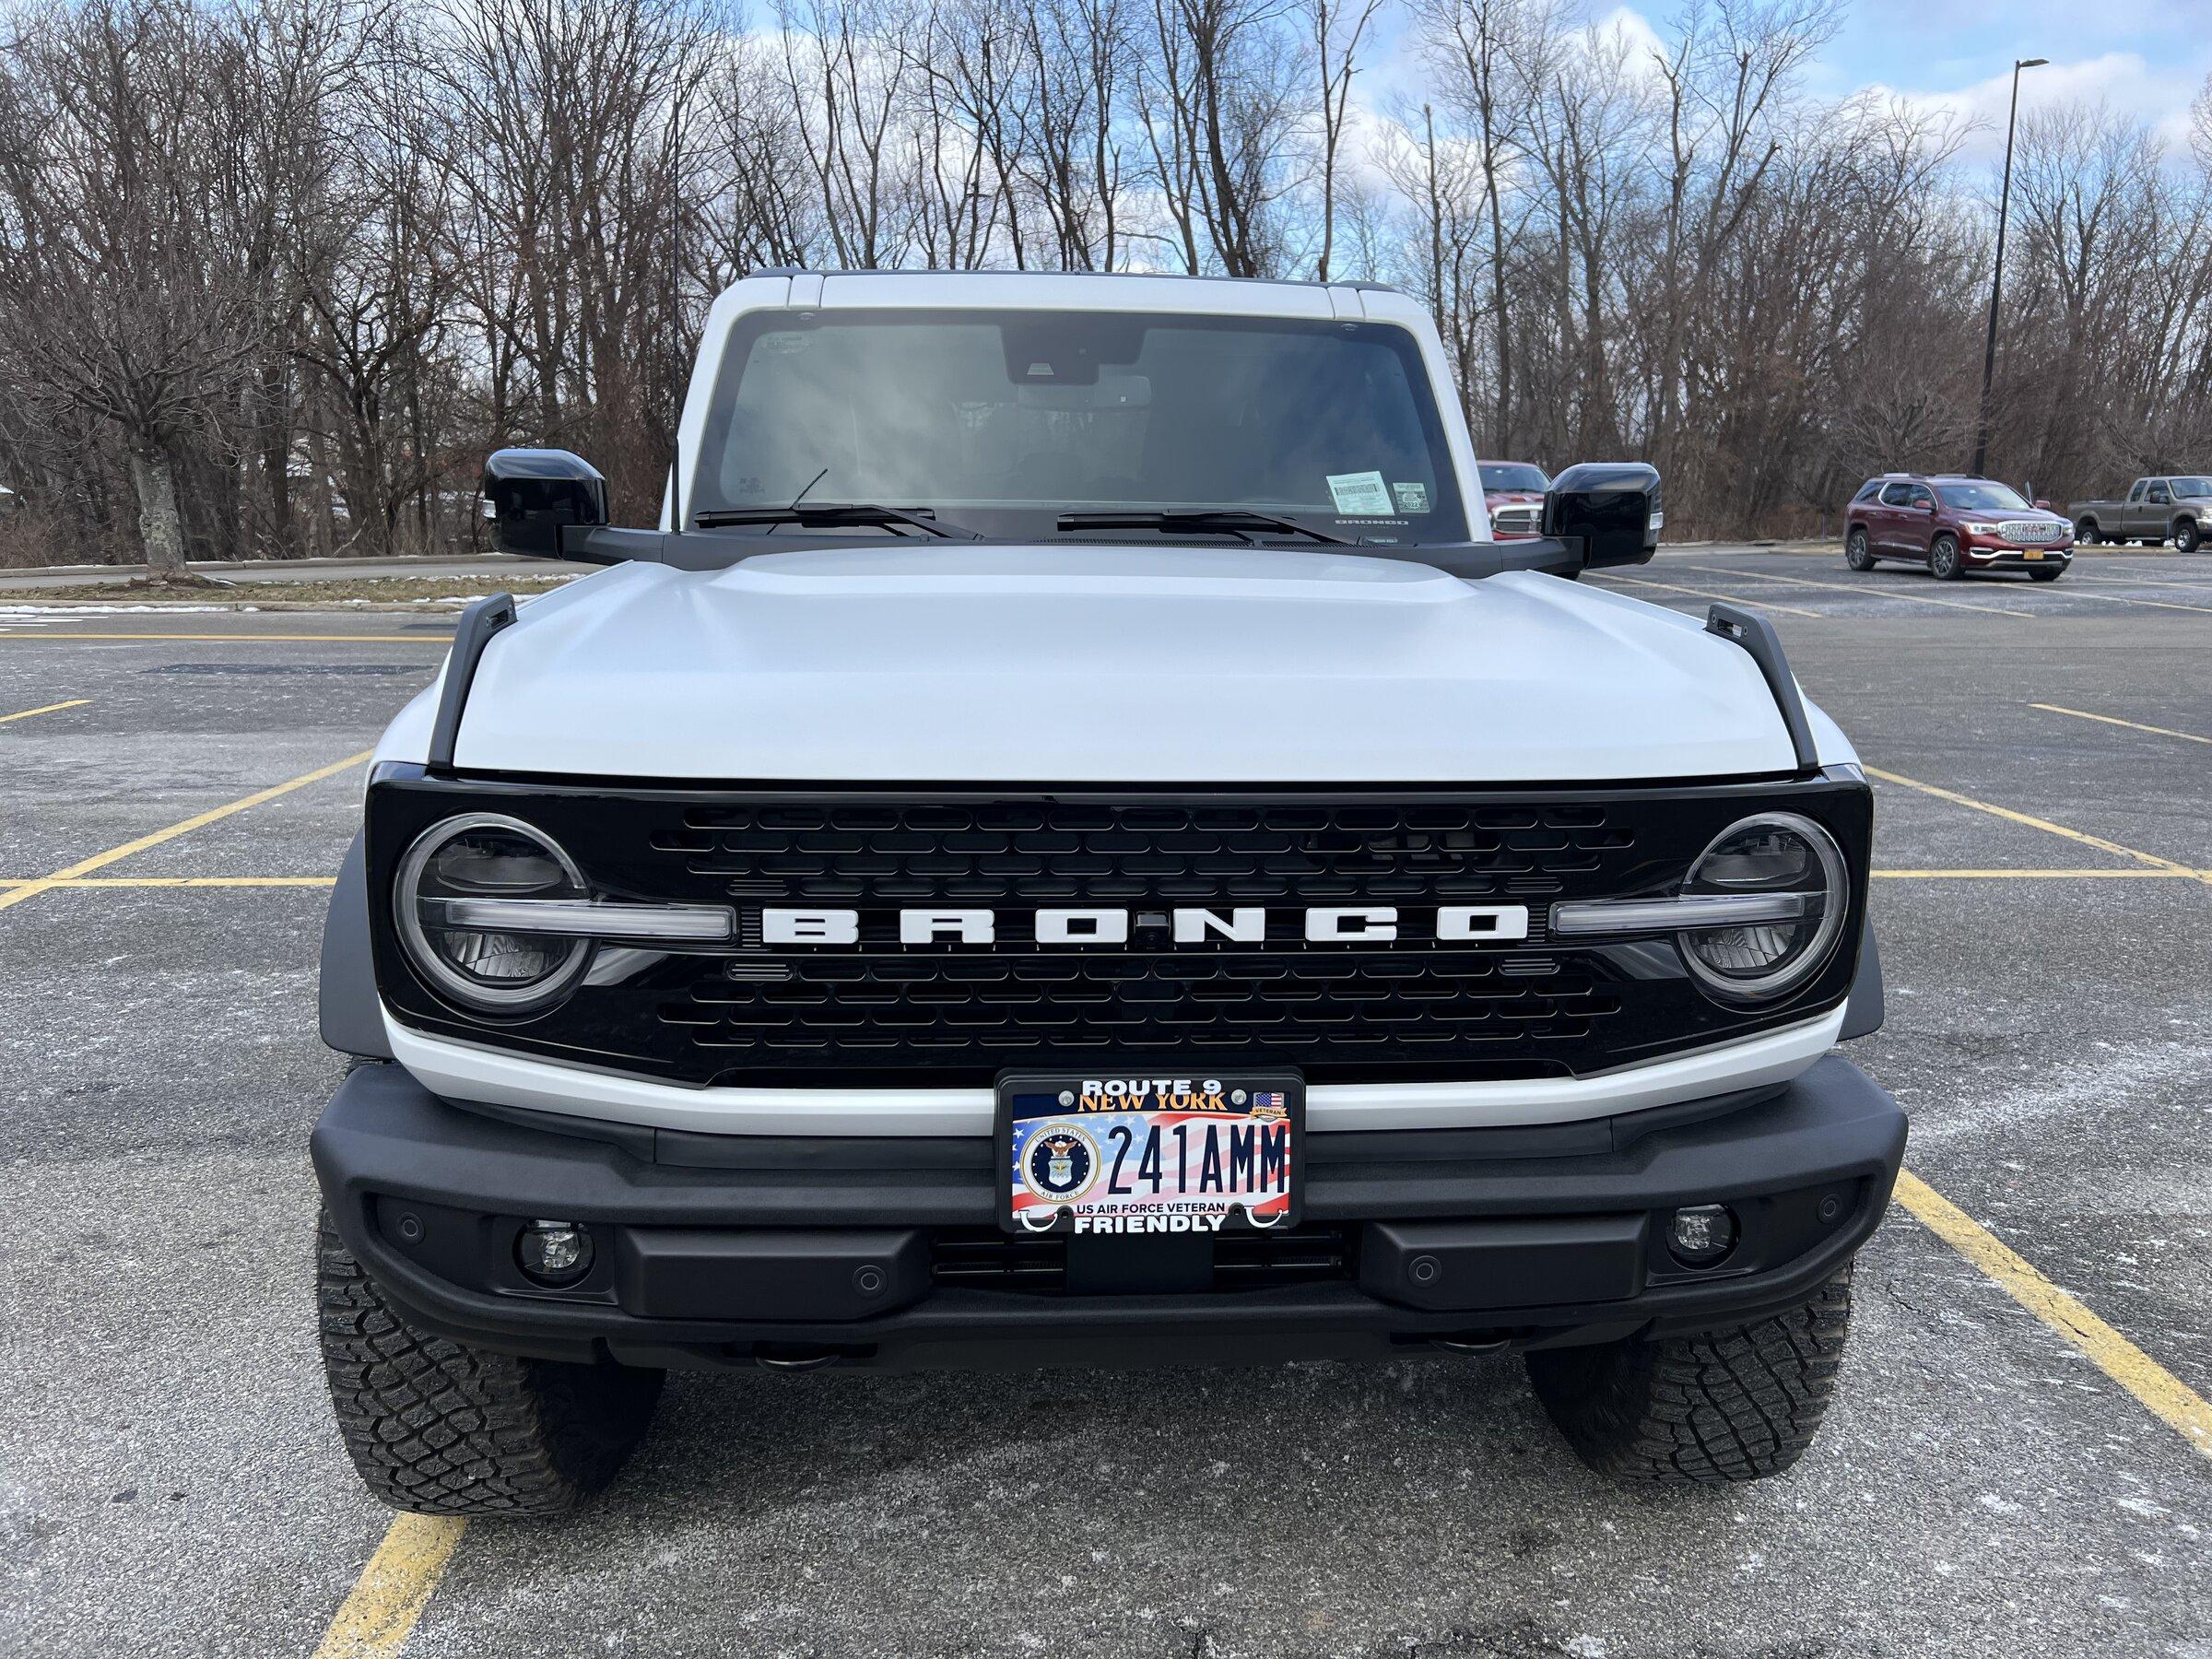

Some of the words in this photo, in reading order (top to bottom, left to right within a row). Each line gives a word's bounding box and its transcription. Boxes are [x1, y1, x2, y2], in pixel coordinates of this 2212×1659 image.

[762, 904, 1529, 945] BRONCO
[1082, 1079, 1192, 1097] ROUTE
[1202, 1079, 1222, 1097] 9
[1077, 1092, 1145, 1112] NEW
[1155, 1091, 1228, 1112] YORK
[1254, 1107, 1282, 1115] VETERAN
[1035, 1128, 1060, 1143] UNITED
[1062, 1127, 1087, 1142] STATES
[1107, 1124, 1287, 1195] 241AMM
[1041, 1190, 1053, 1199] AIR
[1055, 1190, 1079, 1200] FORCE
[1077, 1205, 1095, 1214] US
[1097, 1204, 1120, 1214] AIR
[1122, 1204, 1165, 1214] FORCE
[1167, 1203, 1225, 1213] VETERAN
[1074, 1214, 1227, 1235] FRIENDLY
